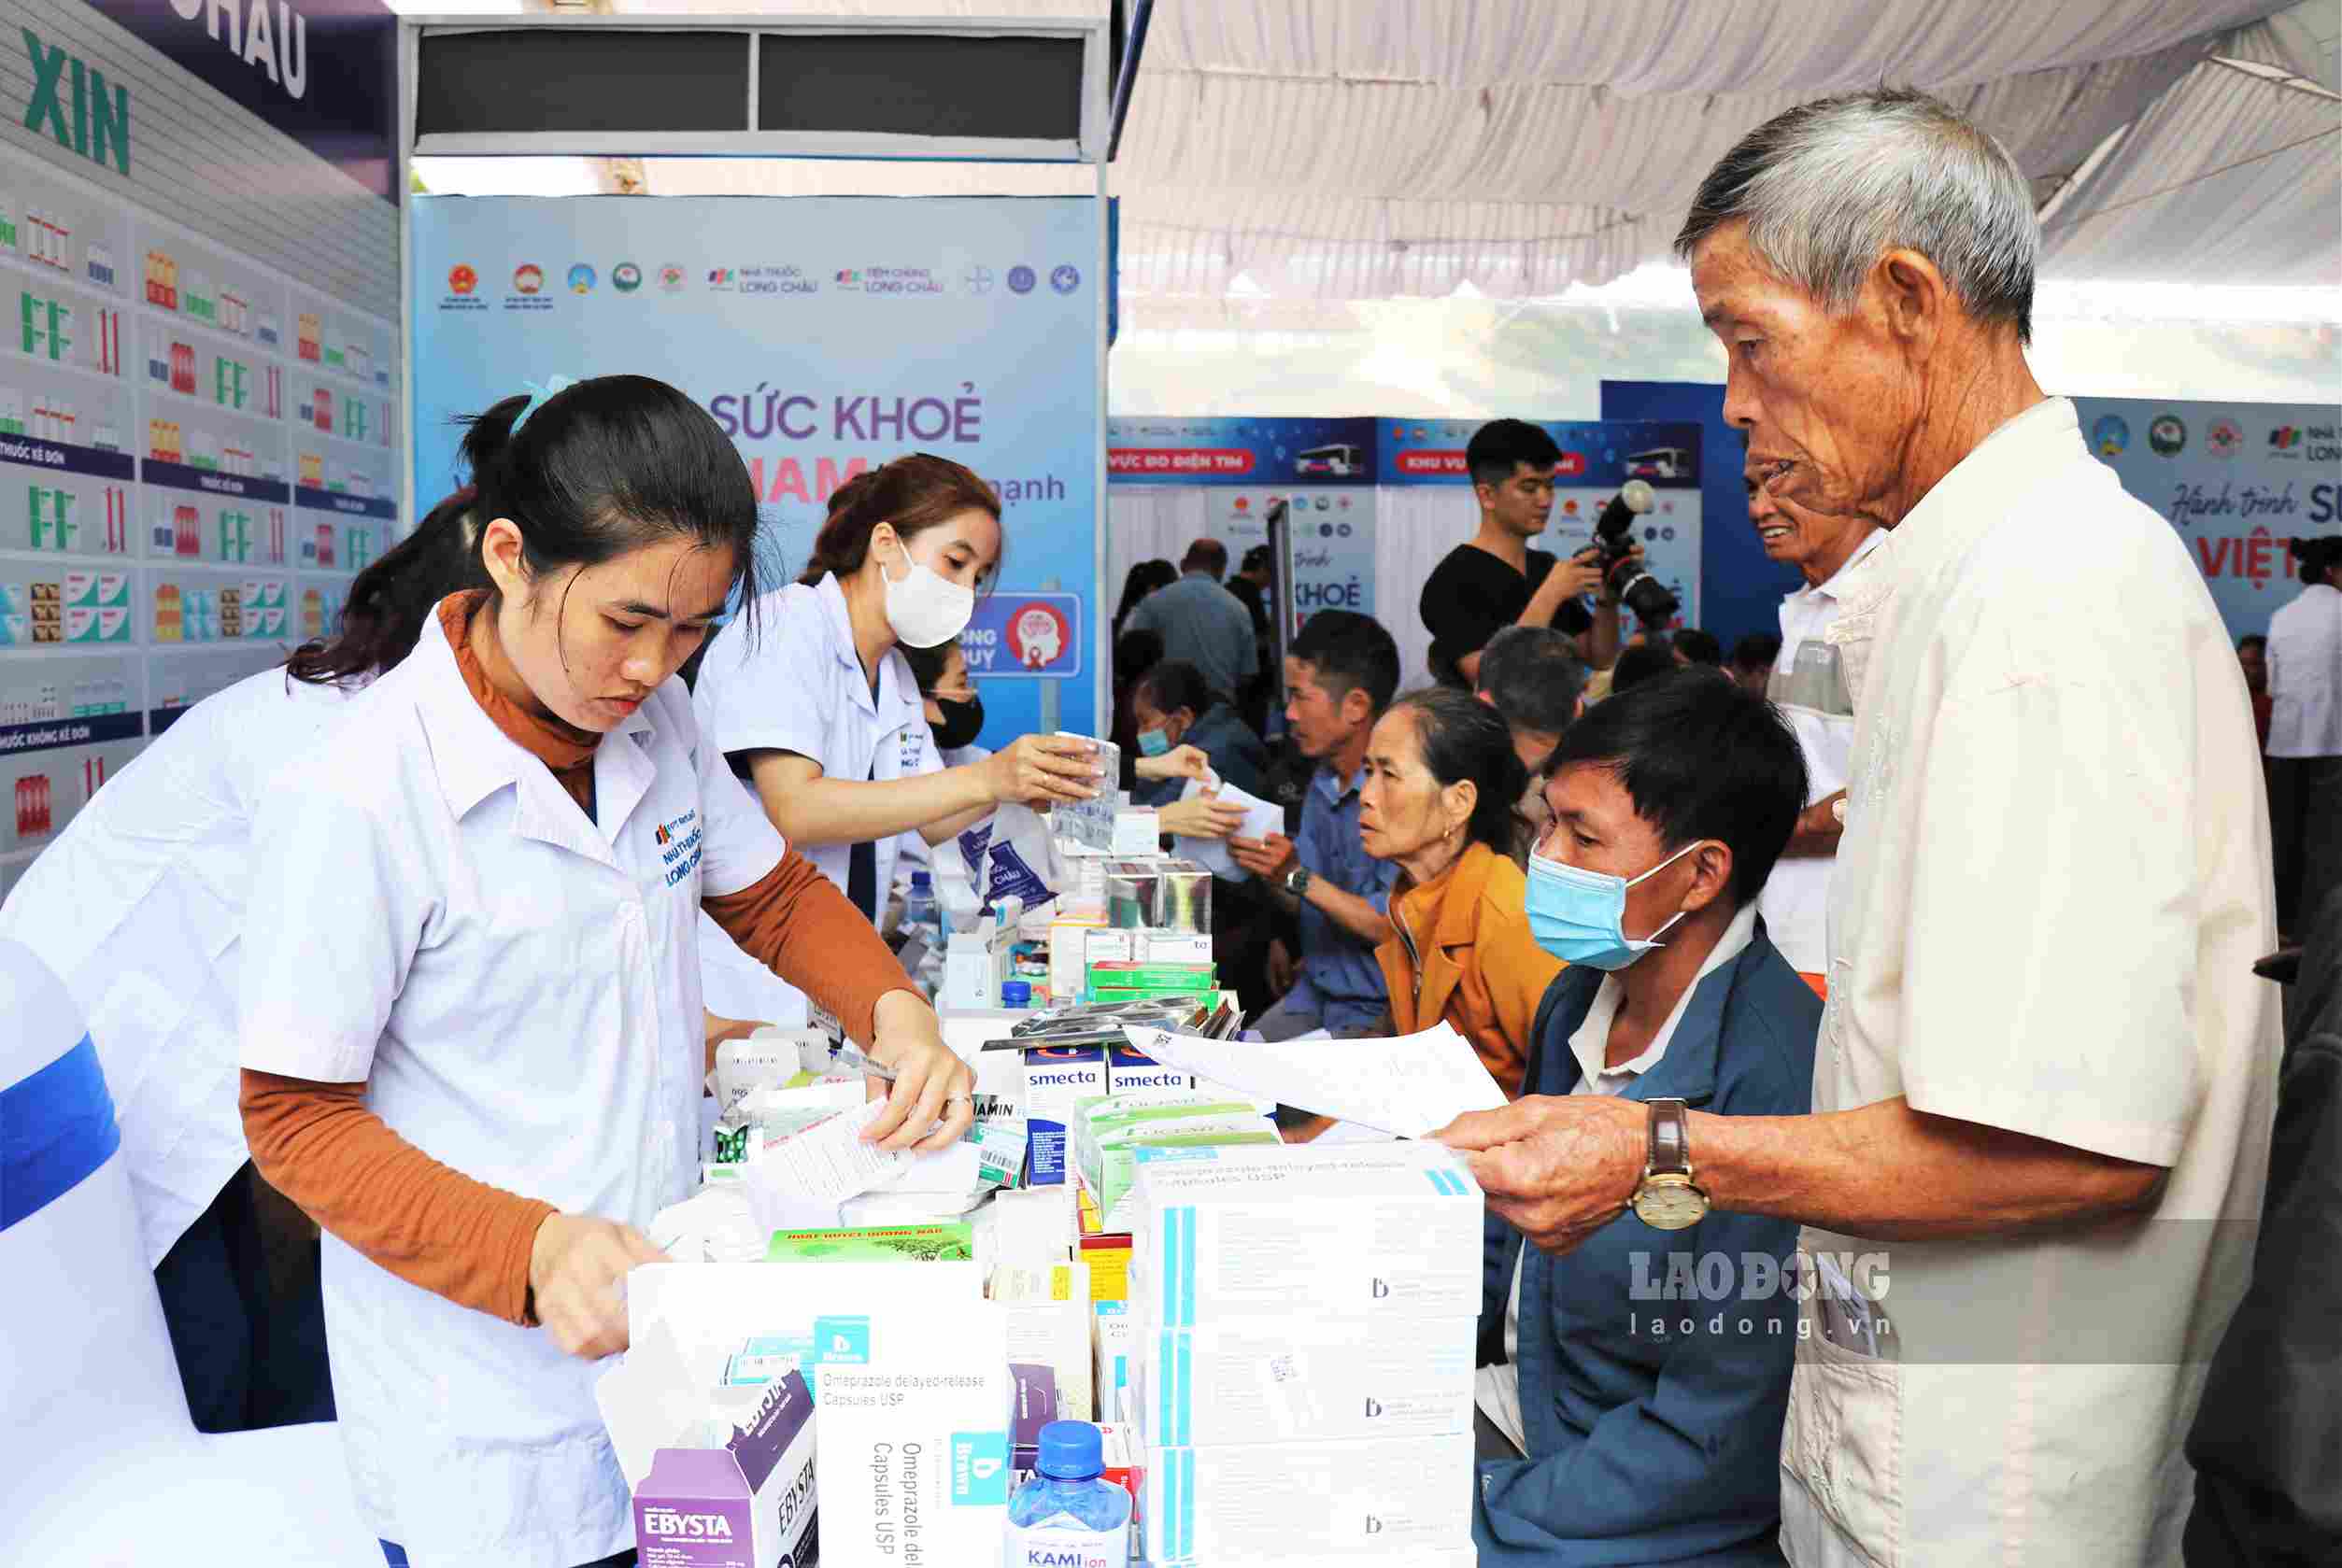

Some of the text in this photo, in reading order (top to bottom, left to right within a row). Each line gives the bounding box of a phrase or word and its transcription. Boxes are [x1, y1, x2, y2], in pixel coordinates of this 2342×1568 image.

[21, 26, 130, 177] XIN
[740, 281, 777, 293] LONG
[866, 281, 903, 293] LONG
[710, 382, 981, 443] SỨC KHOẺ
[1029, 1069, 1096, 1086] smecta
[1114, 1073, 1182, 1088] smecta
[778, 1457, 815, 1535] EBYSTA
[869, 1442, 895, 1555] Capsules USP
[899, 1442, 923, 1538] Omeprazole
[645, 1514, 732, 1536] EBYSTA
